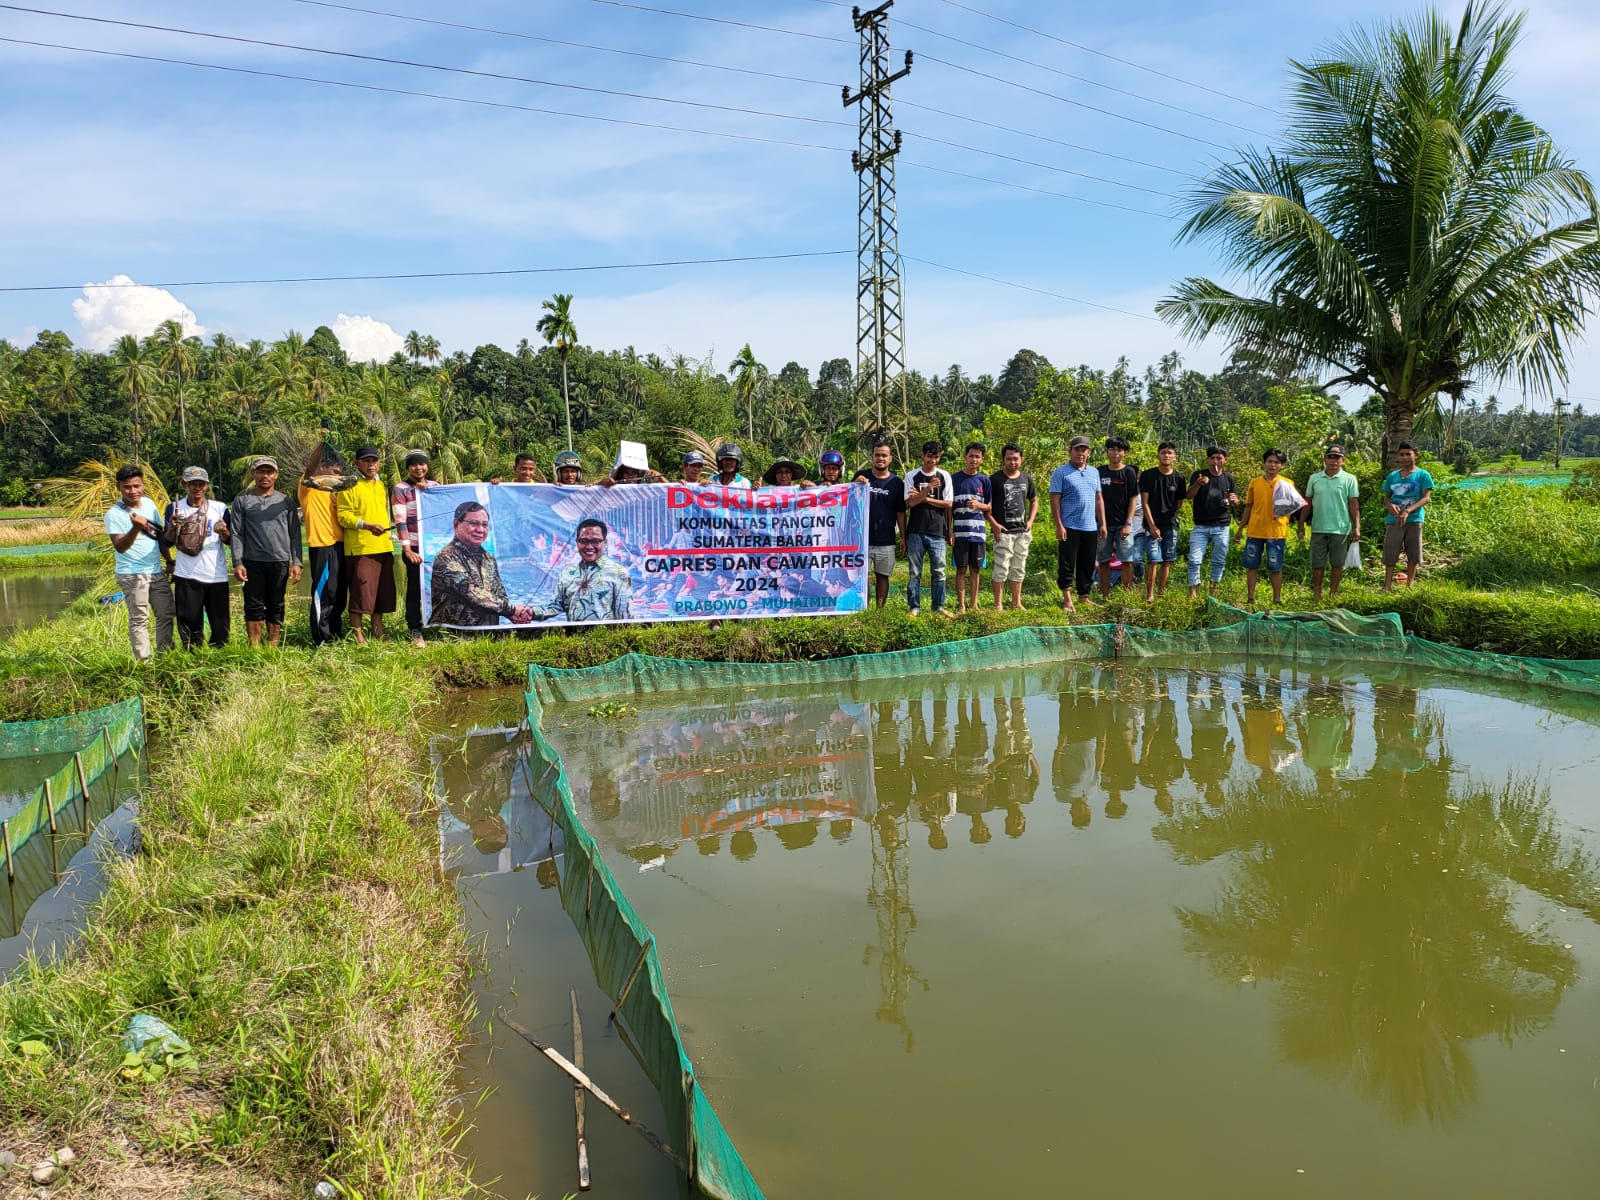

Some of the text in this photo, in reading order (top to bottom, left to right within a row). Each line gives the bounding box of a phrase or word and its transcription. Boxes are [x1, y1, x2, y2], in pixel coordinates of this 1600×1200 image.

[667, 486, 848, 509] Deklarasi
[680, 515, 835, 530] KOMUNITAS PANCING
[694, 534, 822, 548] SUMATERA BARAT
[645, 554, 864, 573] CAPRES DAN CAWAPRES
[735, 577, 779, 592] 2024
[675, 598, 748, 612] PRABOWO
[761, 596, 837, 609] MUHAIMIN
